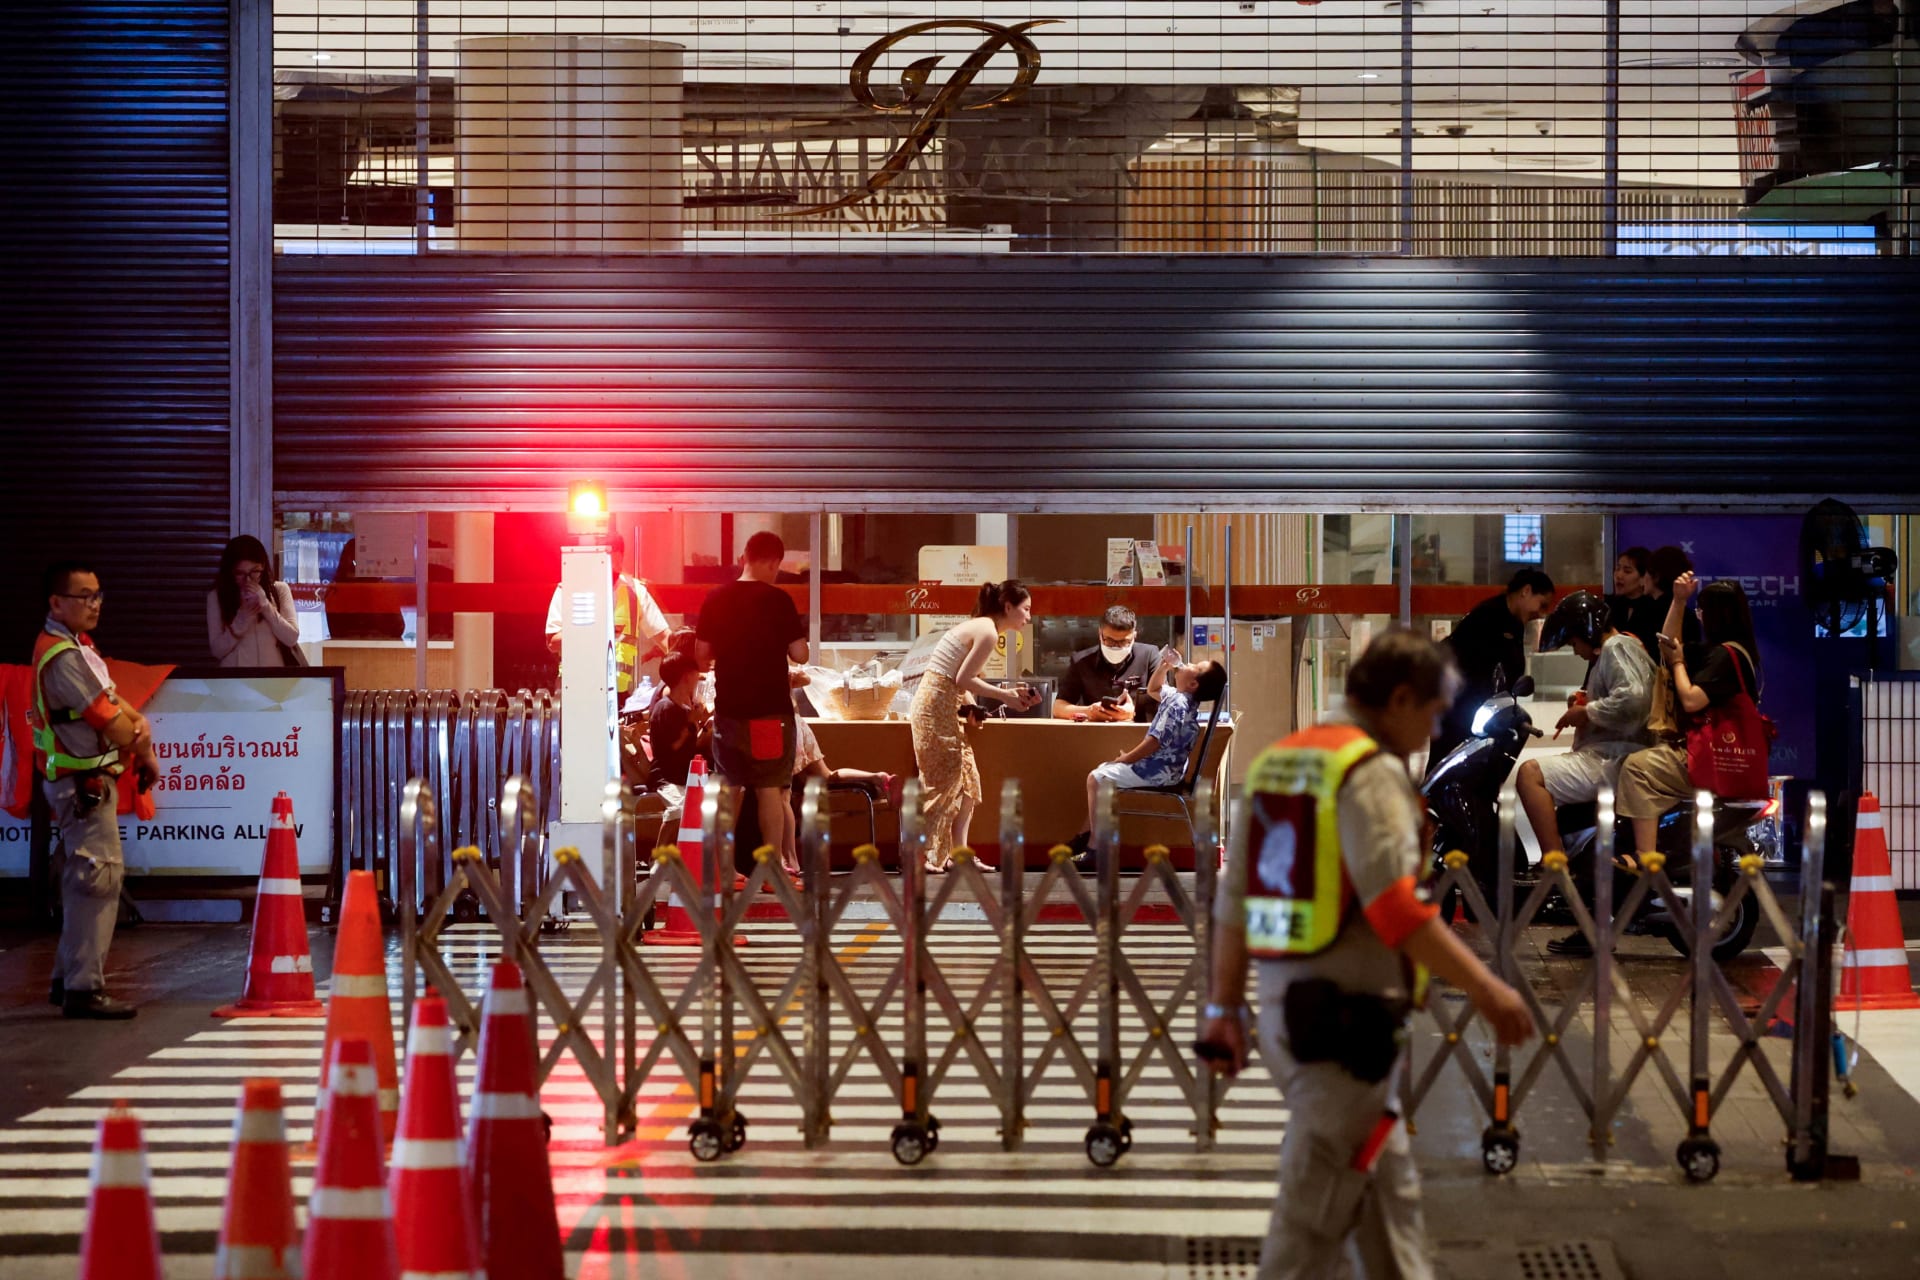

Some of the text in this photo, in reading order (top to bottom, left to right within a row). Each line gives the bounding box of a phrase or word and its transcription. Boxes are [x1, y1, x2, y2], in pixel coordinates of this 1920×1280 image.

[695, 121, 1143, 197] SIAM PARAGON
[152, 726, 302, 758] ยนต์บริเวณนี้
[137, 825, 224, 840] PARKING
